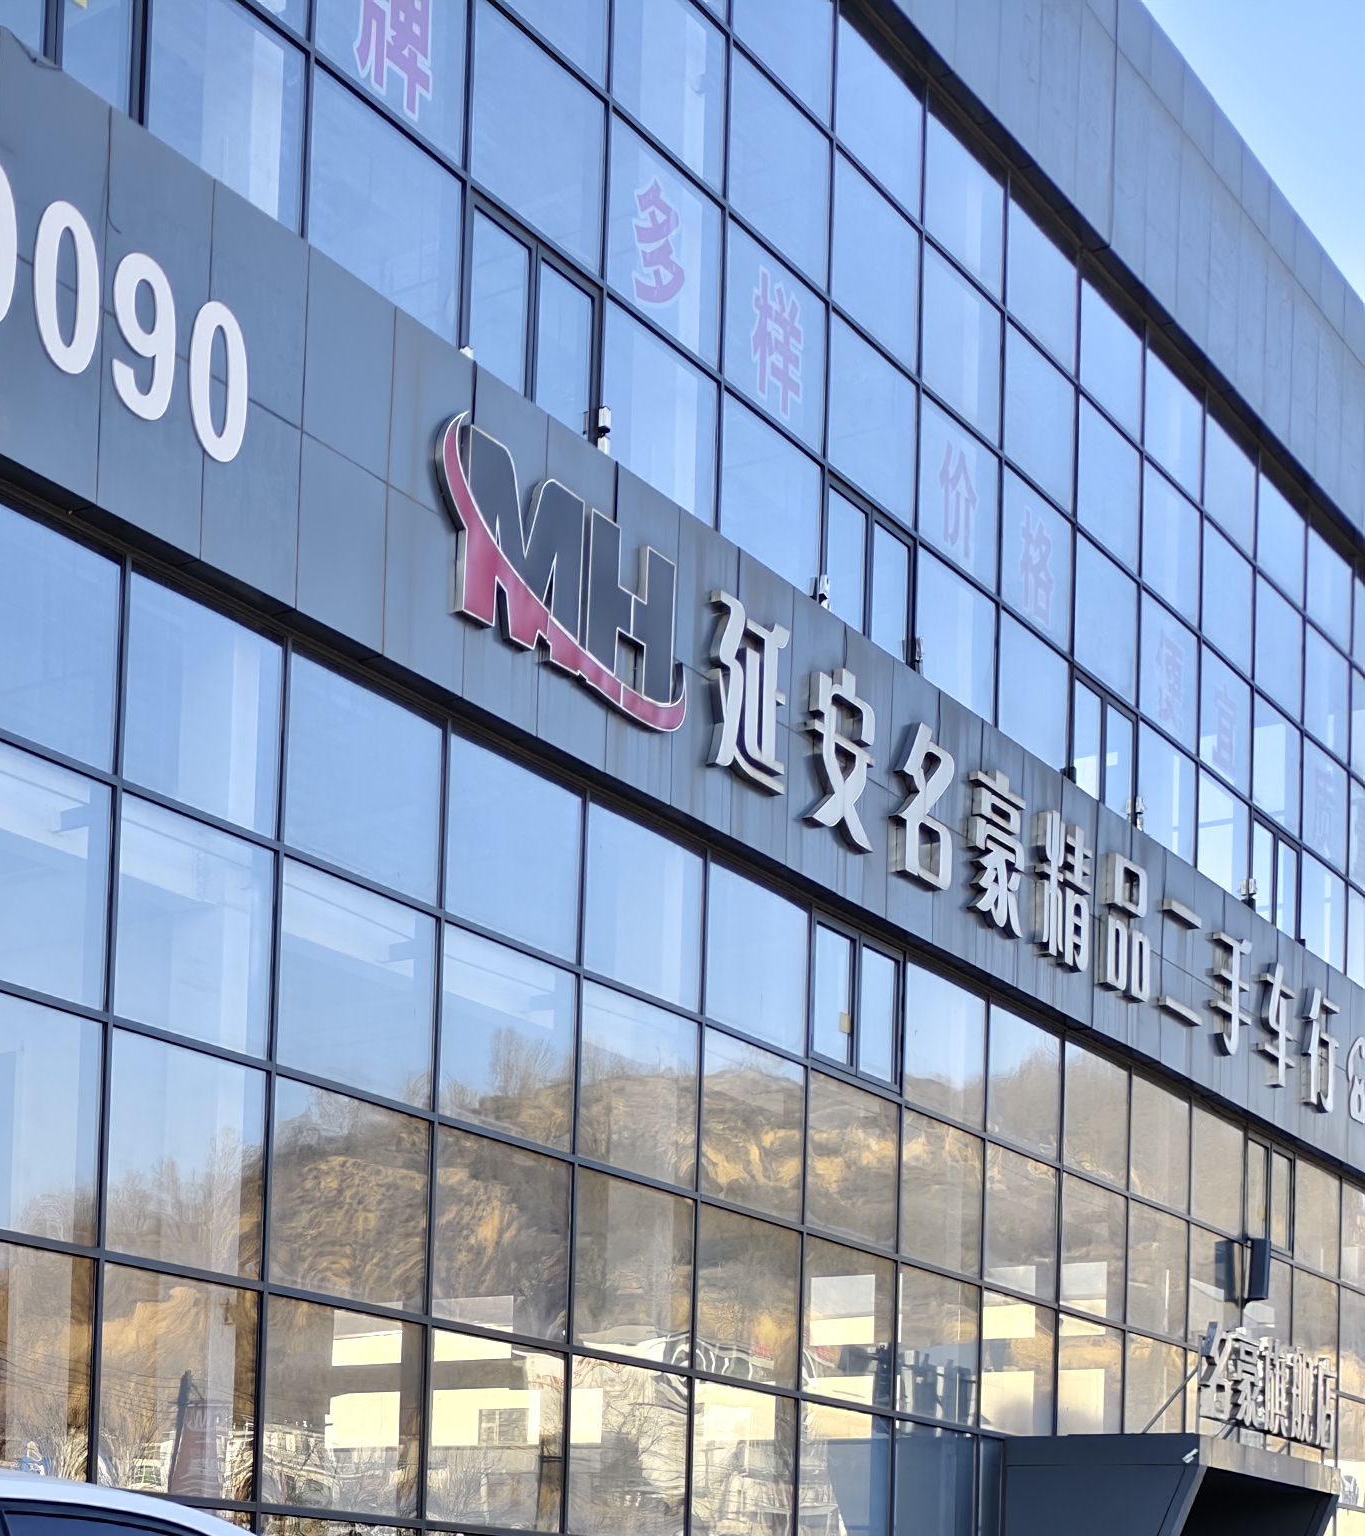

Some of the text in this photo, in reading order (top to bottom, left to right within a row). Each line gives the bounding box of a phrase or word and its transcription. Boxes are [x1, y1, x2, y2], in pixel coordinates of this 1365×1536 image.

[707, 590, 1341, 1114] 延安名豪精品二手车行
